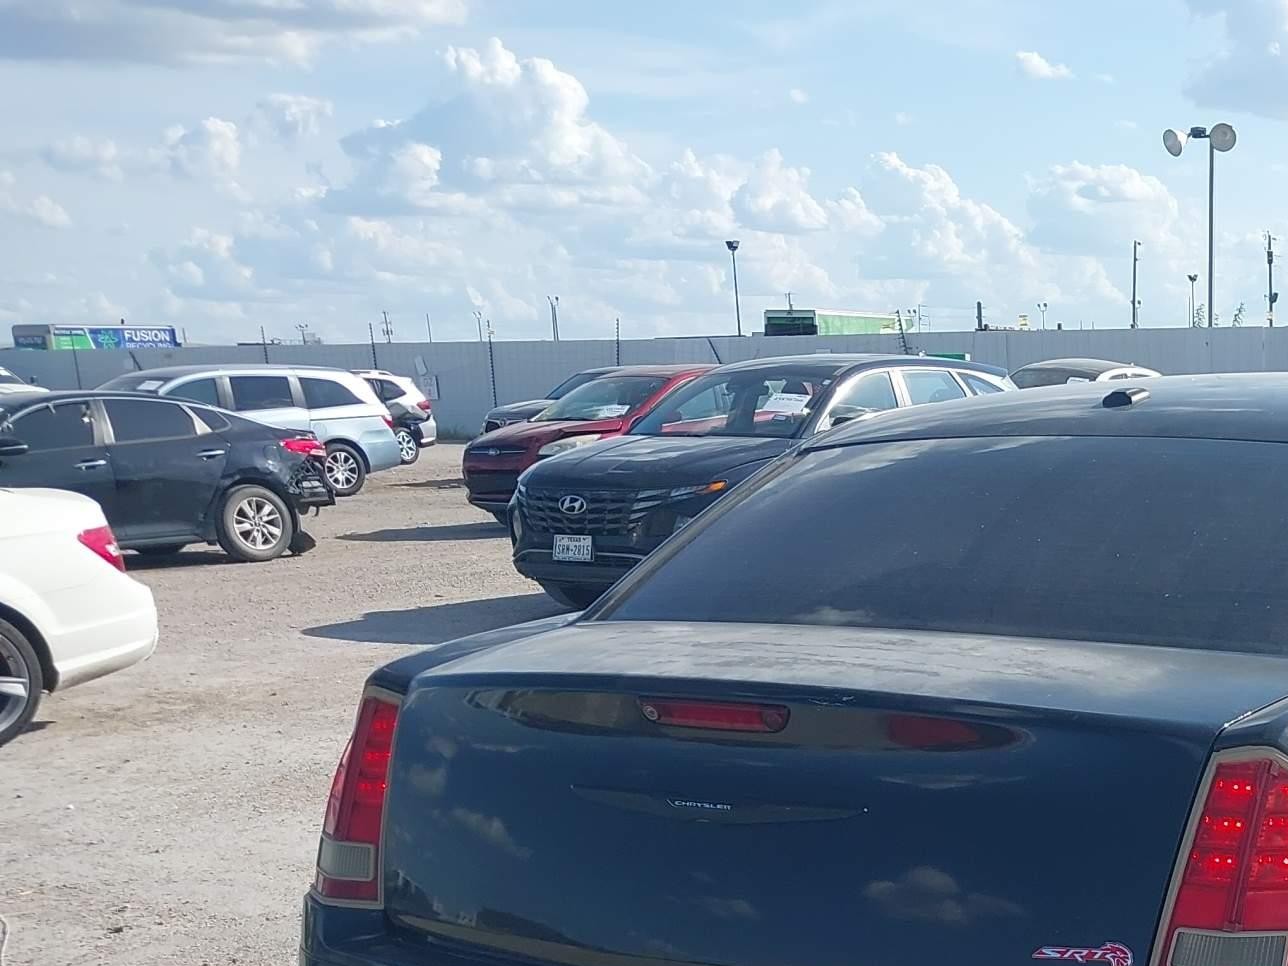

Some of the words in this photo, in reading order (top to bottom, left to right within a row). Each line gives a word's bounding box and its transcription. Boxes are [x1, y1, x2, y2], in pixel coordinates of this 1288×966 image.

[124, 329, 170, 342] FUSION
[674, 800, 732, 811] CHRYSLER
[1032, 946, 1110, 963] SRT
